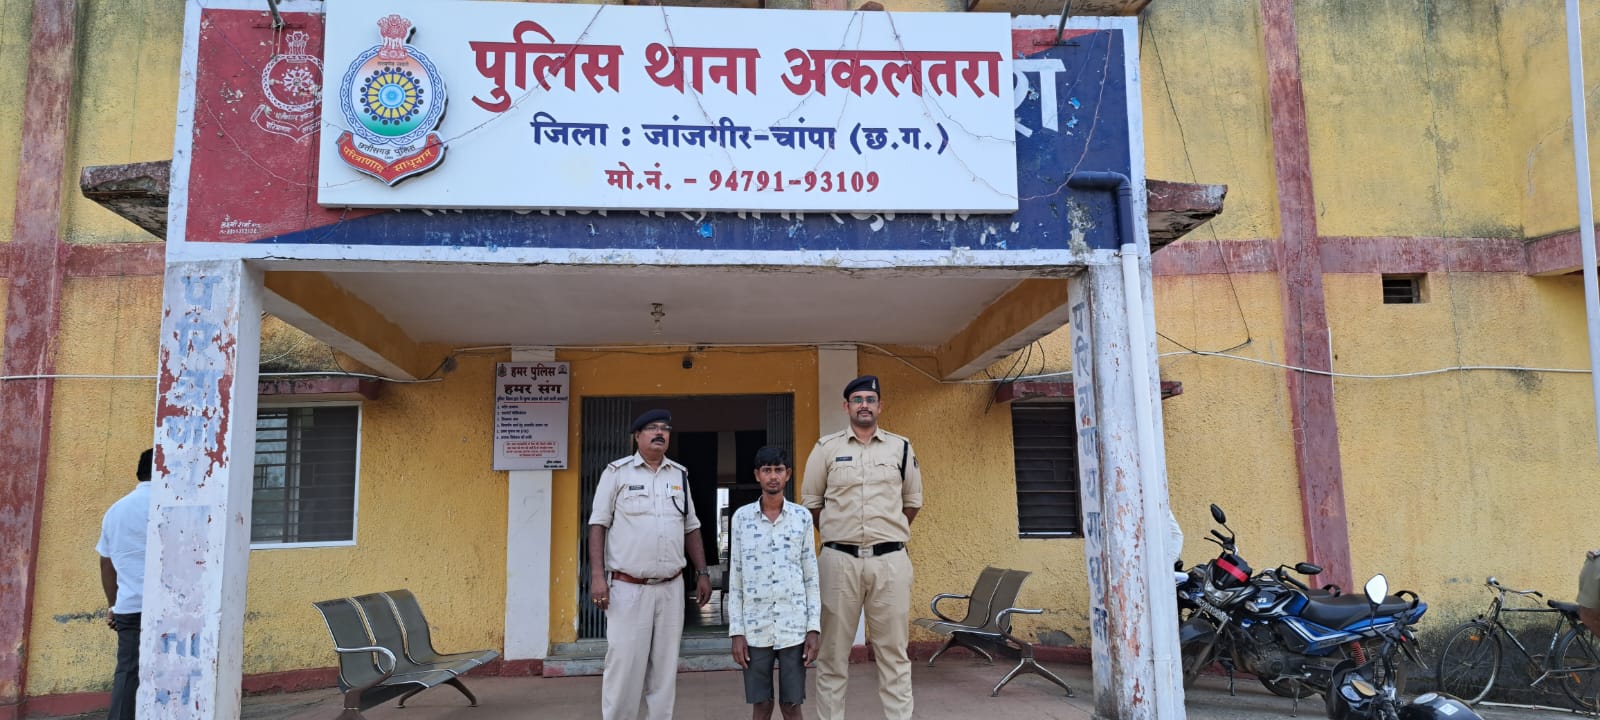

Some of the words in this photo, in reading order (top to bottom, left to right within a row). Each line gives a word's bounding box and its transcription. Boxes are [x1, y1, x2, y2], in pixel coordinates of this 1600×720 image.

[470, 21, 623, 113] पुलिस
[645, 42, 760, 94] थाना
[780, 49, 1003, 98] अकलतरा
[529, 111, 609, 147] जिला
[641, 114, 837, 150] जांजगीर-चांपा
[849, 122, 949, 155] (छ.ग.)
[604, 161, 672, 190] मो.नं.
[709, 169, 880, 192] 94791-93109
[511, 366, 527, 377] हमर
[531, 363, 556, 380] पुलिस
[504, 384, 532, 395] हमर
[538, 380, 562, 394] संग
